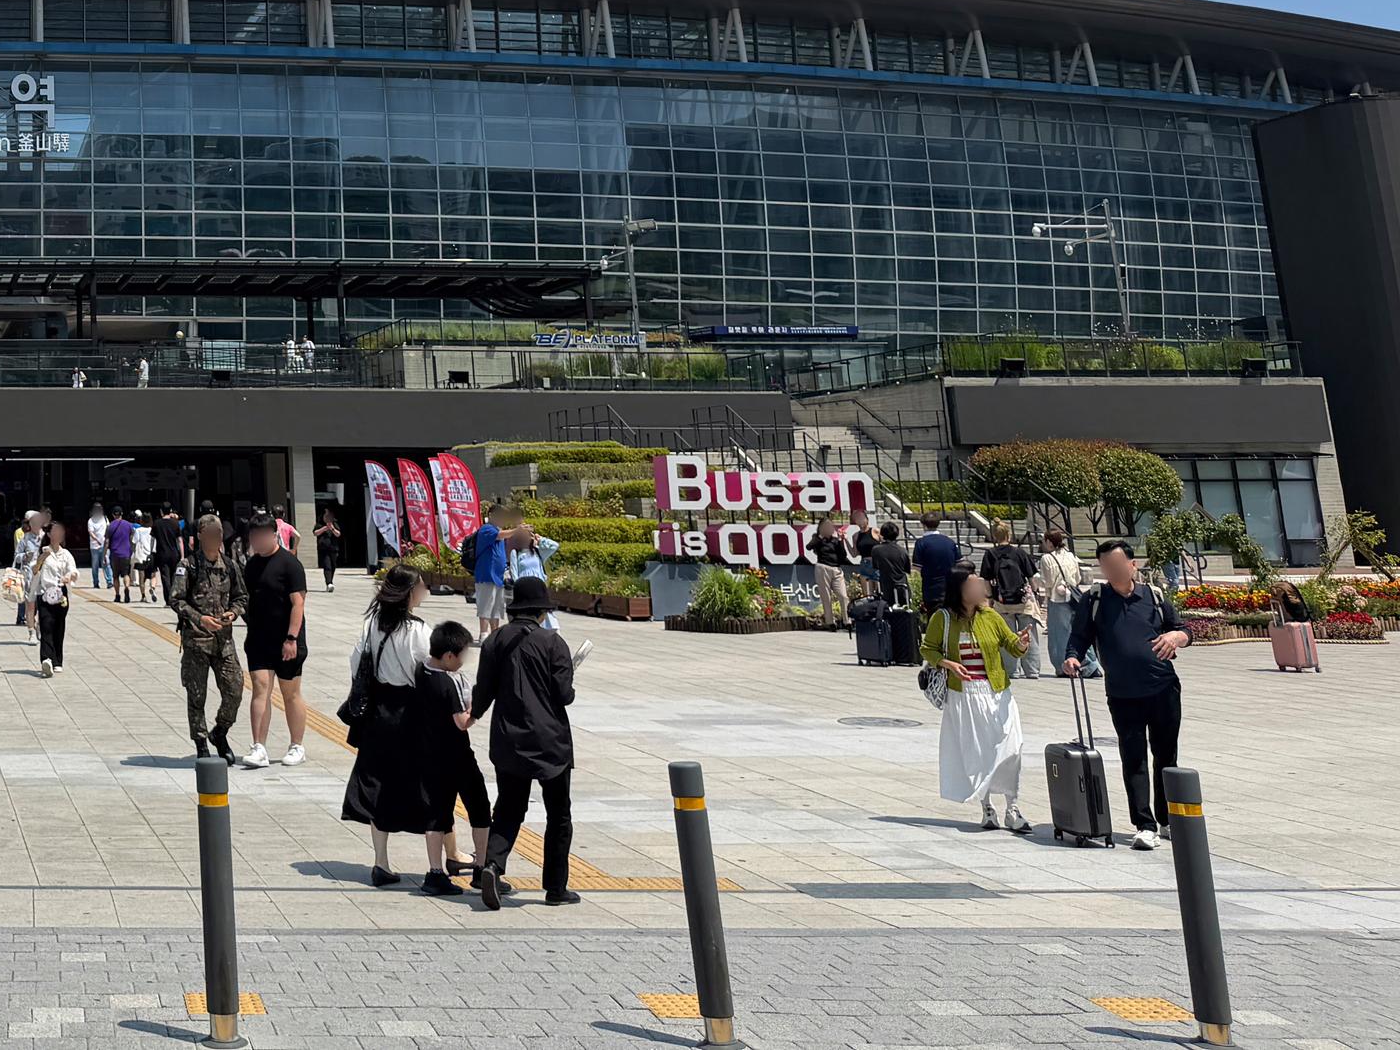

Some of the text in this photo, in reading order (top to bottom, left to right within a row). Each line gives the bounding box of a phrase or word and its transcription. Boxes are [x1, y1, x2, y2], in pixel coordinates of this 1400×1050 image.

[17, 132, 70, 152] 釜山驛
[575, 334, 640, 345] PLATFORM
[666, 455, 876, 512] Busan
[671, 522, 709, 557] is
